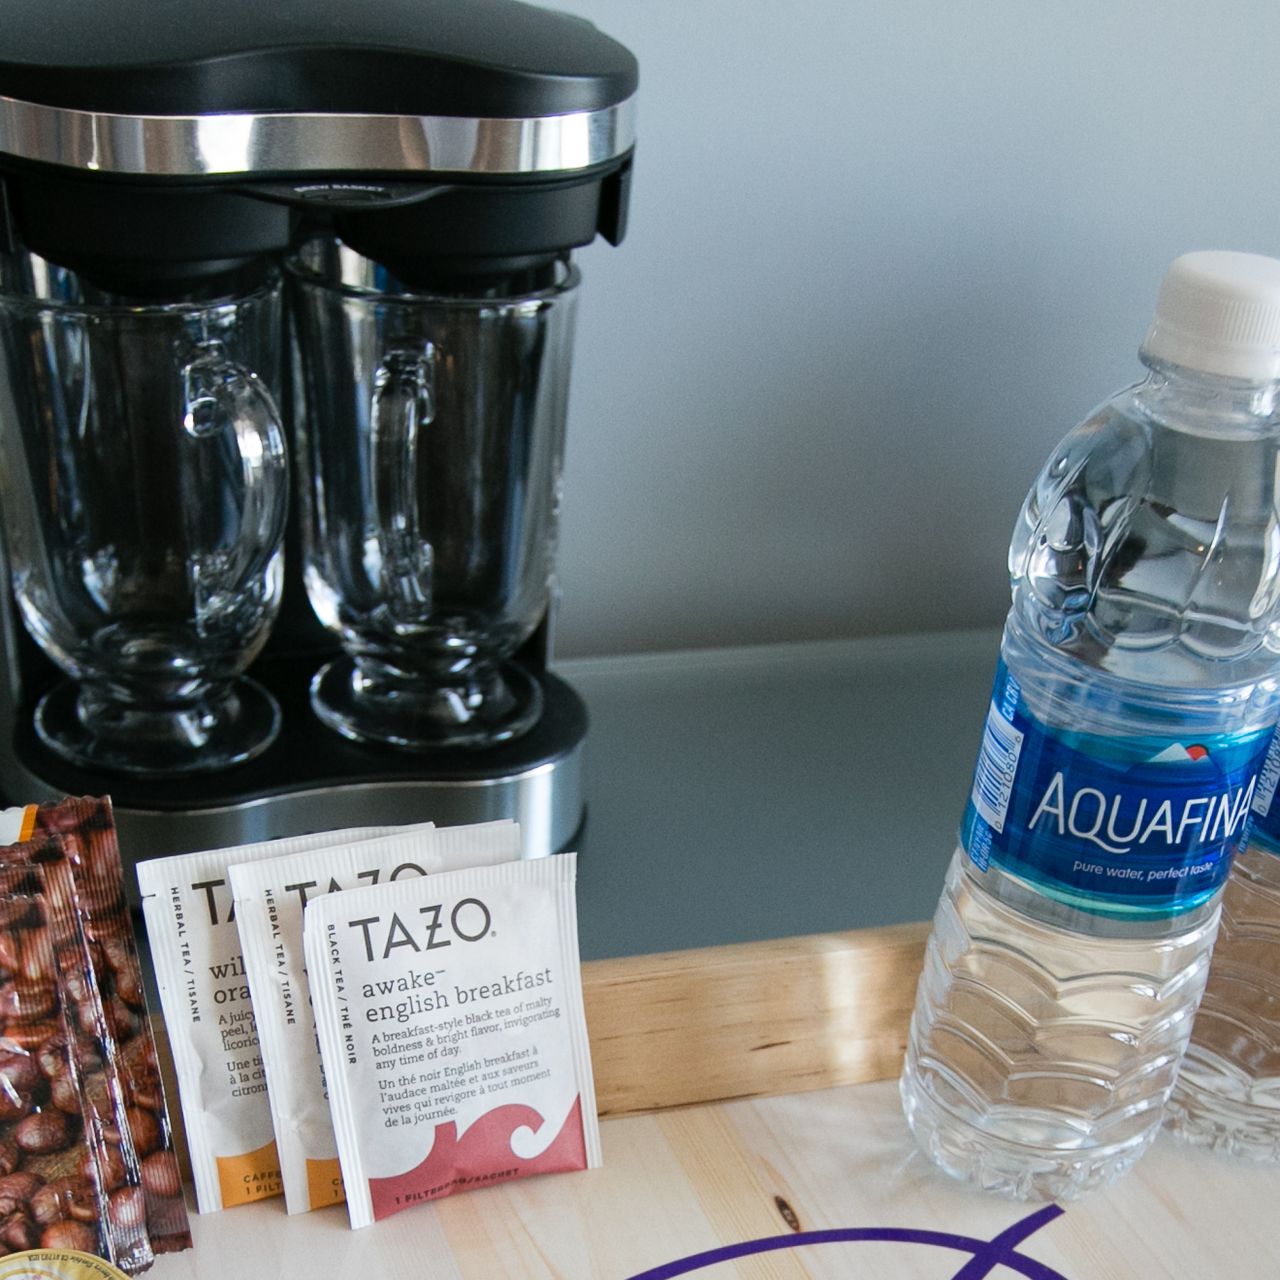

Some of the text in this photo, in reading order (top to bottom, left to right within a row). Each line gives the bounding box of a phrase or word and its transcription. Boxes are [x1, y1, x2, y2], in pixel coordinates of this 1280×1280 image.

[1028, 771, 1257, 854] AQUAFINA
[1073, 859, 1213, 882] pure water, perfect taste
[264, 889, 280, 939] HERBAL
[349, 898, 491, 962] TAZO
[171, 887, 186, 938] HERBAL
[180, 942, 191, 967] TEA
[186, 979, 201, 1023] TISANE
[275, 944, 288, 968] TEA
[328, 924, 340, 964] BLACK
[335, 970, 344, 992] TEA
[366, 968, 553, 1023] english breakfast
[219, 1014, 228, 1025] A
[281, 981, 296, 1025] TISANE
[341, 1007, 352, 1029] THÉ
[372, 996, 552, 1044] A breakfast-style black tea of malty
[221, 1022, 249, 1041] peel,
[373, 1007, 560, 1057] boldness & bright flavor, invigorating
[227, 1060, 250, 1072] Une
[345, 1035, 357, 1064] NOIR
[376, 1045, 461, 1073] any time of day.
[239, 1072, 250, 1083] la
[379, 1080, 395, 1090] Un
[398, 1075, 416, 1087] thé
[420, 1070, 441, 1083] noir
[444, 1060, 481, 1079] English
[484, 1049, 530, 1068] breakfast
[430, 1078, 466, 1094] maltée
[469, 1075, 479, 1085] et
[482, 1071, 500, 1081] aux
[502, 1060, 539, 1076] saveurs
[382, 1103, 412, 1116] vives
[414, 1099, 432, 1113] qui
[434, 1090, 477, 1108] revigore
[488, 1081, 508, 1093] tout
[511, 1068, 551, 1088] moment
[385, 1106, 458, 1128] de la journée.
